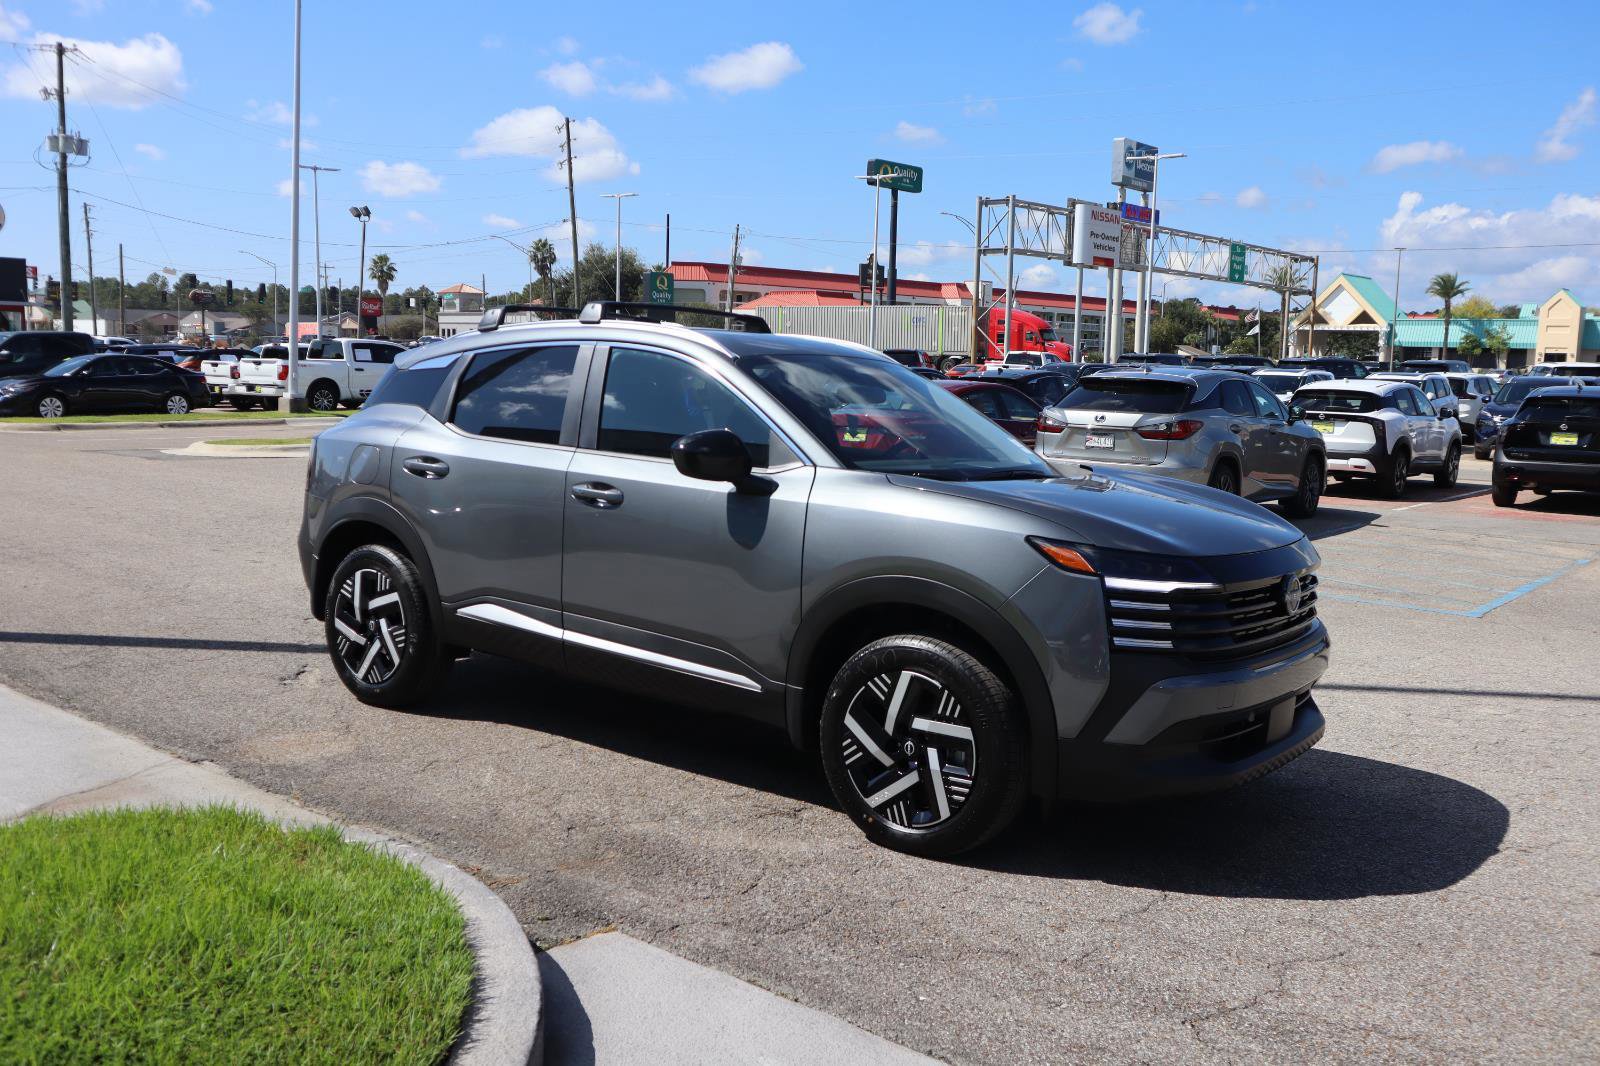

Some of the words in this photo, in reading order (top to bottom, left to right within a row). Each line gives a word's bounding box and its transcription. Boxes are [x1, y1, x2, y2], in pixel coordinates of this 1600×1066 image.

[894, 166, 917, 181] Quality
[1091, 209, 1120, 225] NISSAN
[1090, 230, 1119, 242] Pre-Owned
[1093, 242, 1116, 252] Vehicles
[656, 274, 668, 290] Q
[652, 290, 672, 300] Quality
